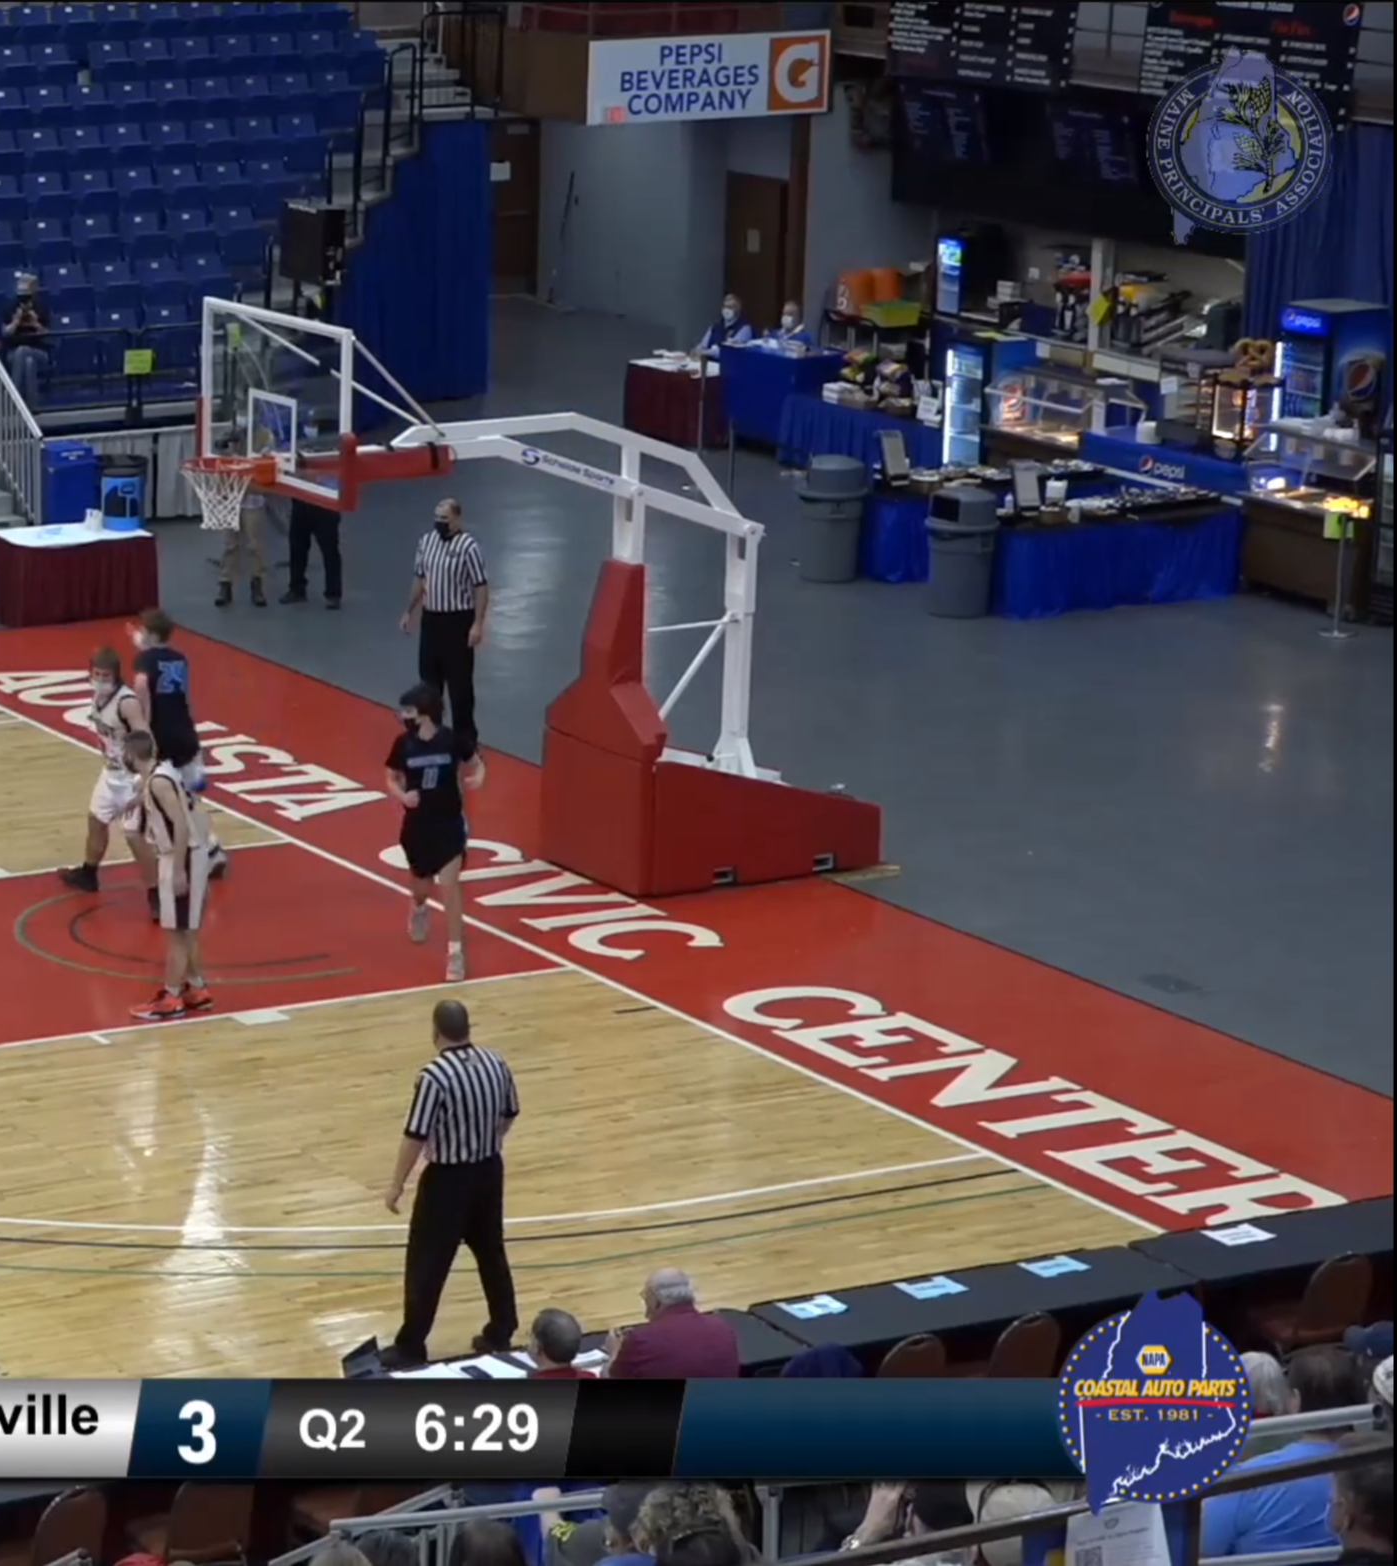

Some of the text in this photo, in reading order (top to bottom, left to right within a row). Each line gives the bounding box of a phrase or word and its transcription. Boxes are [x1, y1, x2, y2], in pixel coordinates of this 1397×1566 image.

[660, 43, 723, 66] PEPSI
[620, 65, 759, 92] BEVERAGES
[774, 42, 820, 103] G
[627, 89, 752, 116] COMPANY
[1153, 462, 1186, 480] pepsi
[722, 985, 1349, 1226] CENTER
